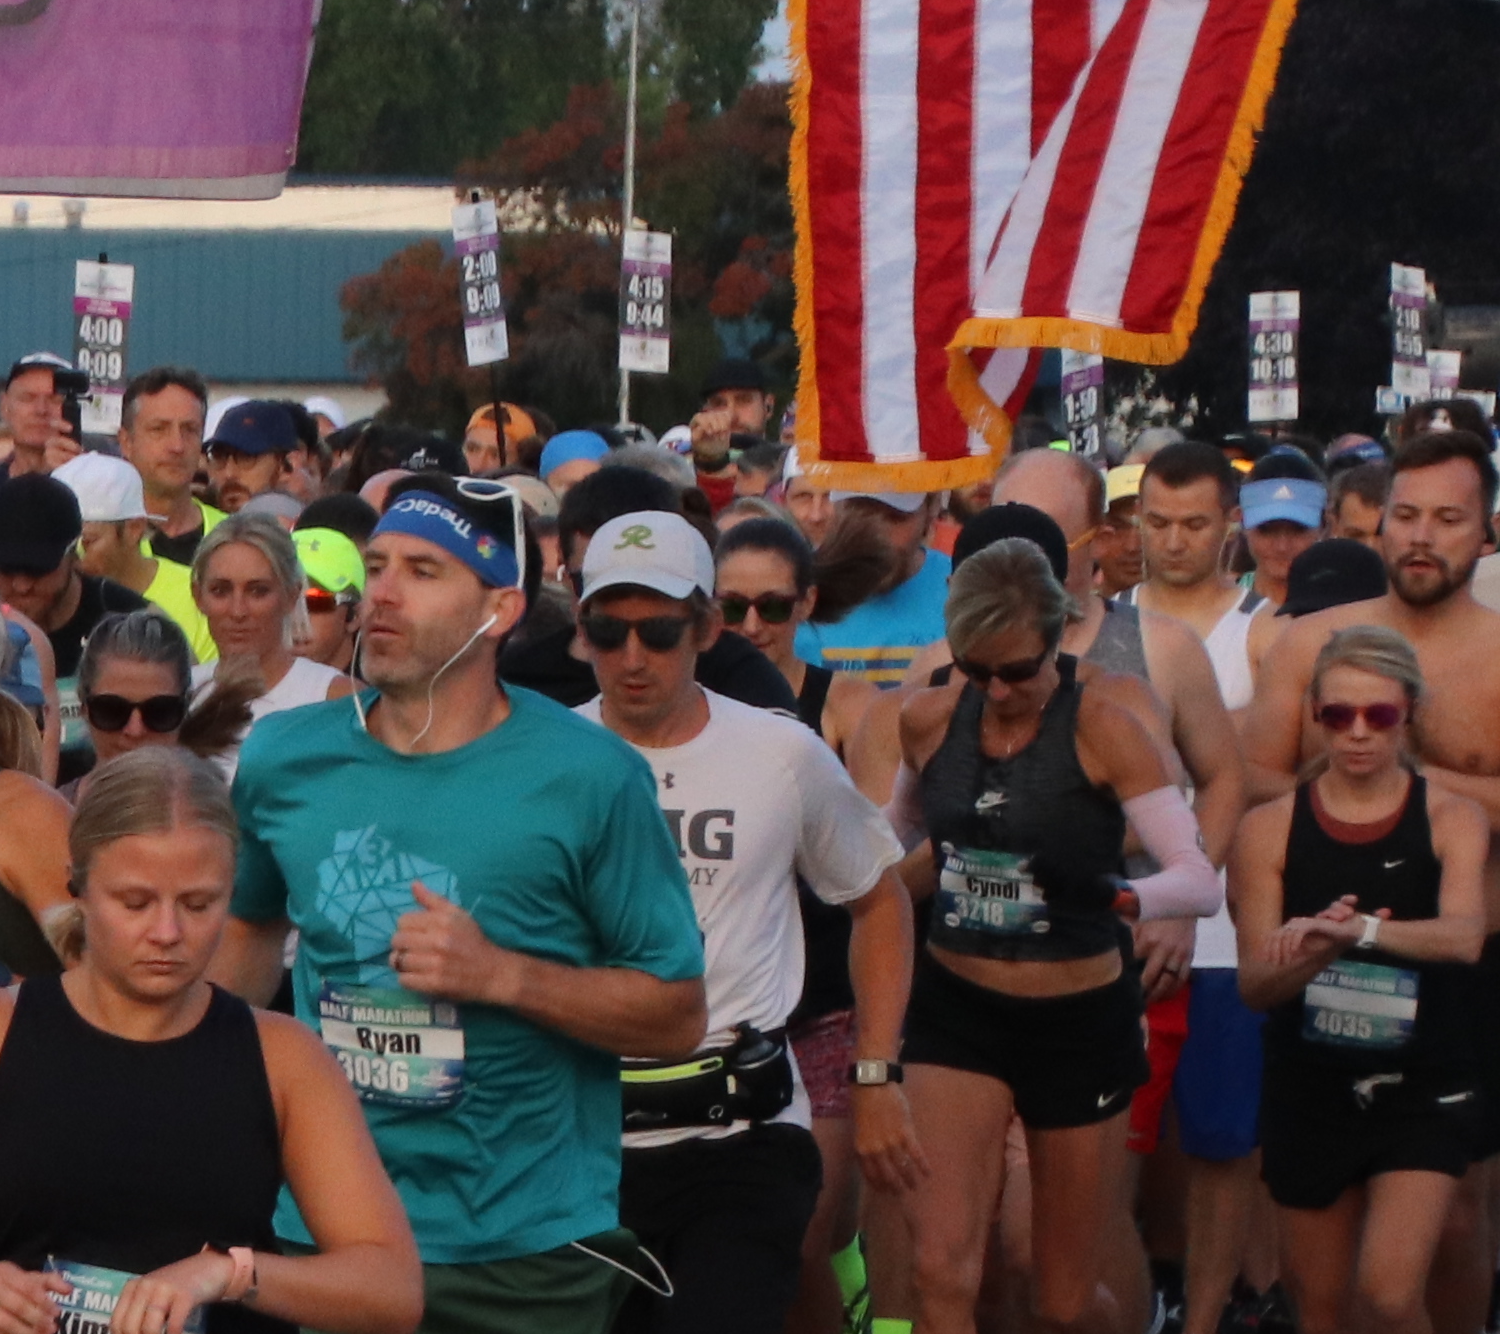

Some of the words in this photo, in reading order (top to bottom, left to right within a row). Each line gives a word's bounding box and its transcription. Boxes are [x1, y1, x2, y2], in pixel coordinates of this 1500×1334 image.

[462, 250, 498, 282] 2:00
[628, 274, 665, 301] 4:15
[79, 315, 124, 347] 4:00
[1254, 331, 1294, 354] 4:30
[1251, 355, 1297, 381] 10:18
[1314, 1009, 1373, 1039] 4035
[356, 1027, 422, 1056] Ryan
[337, 1050, 410, 1094] 3036
